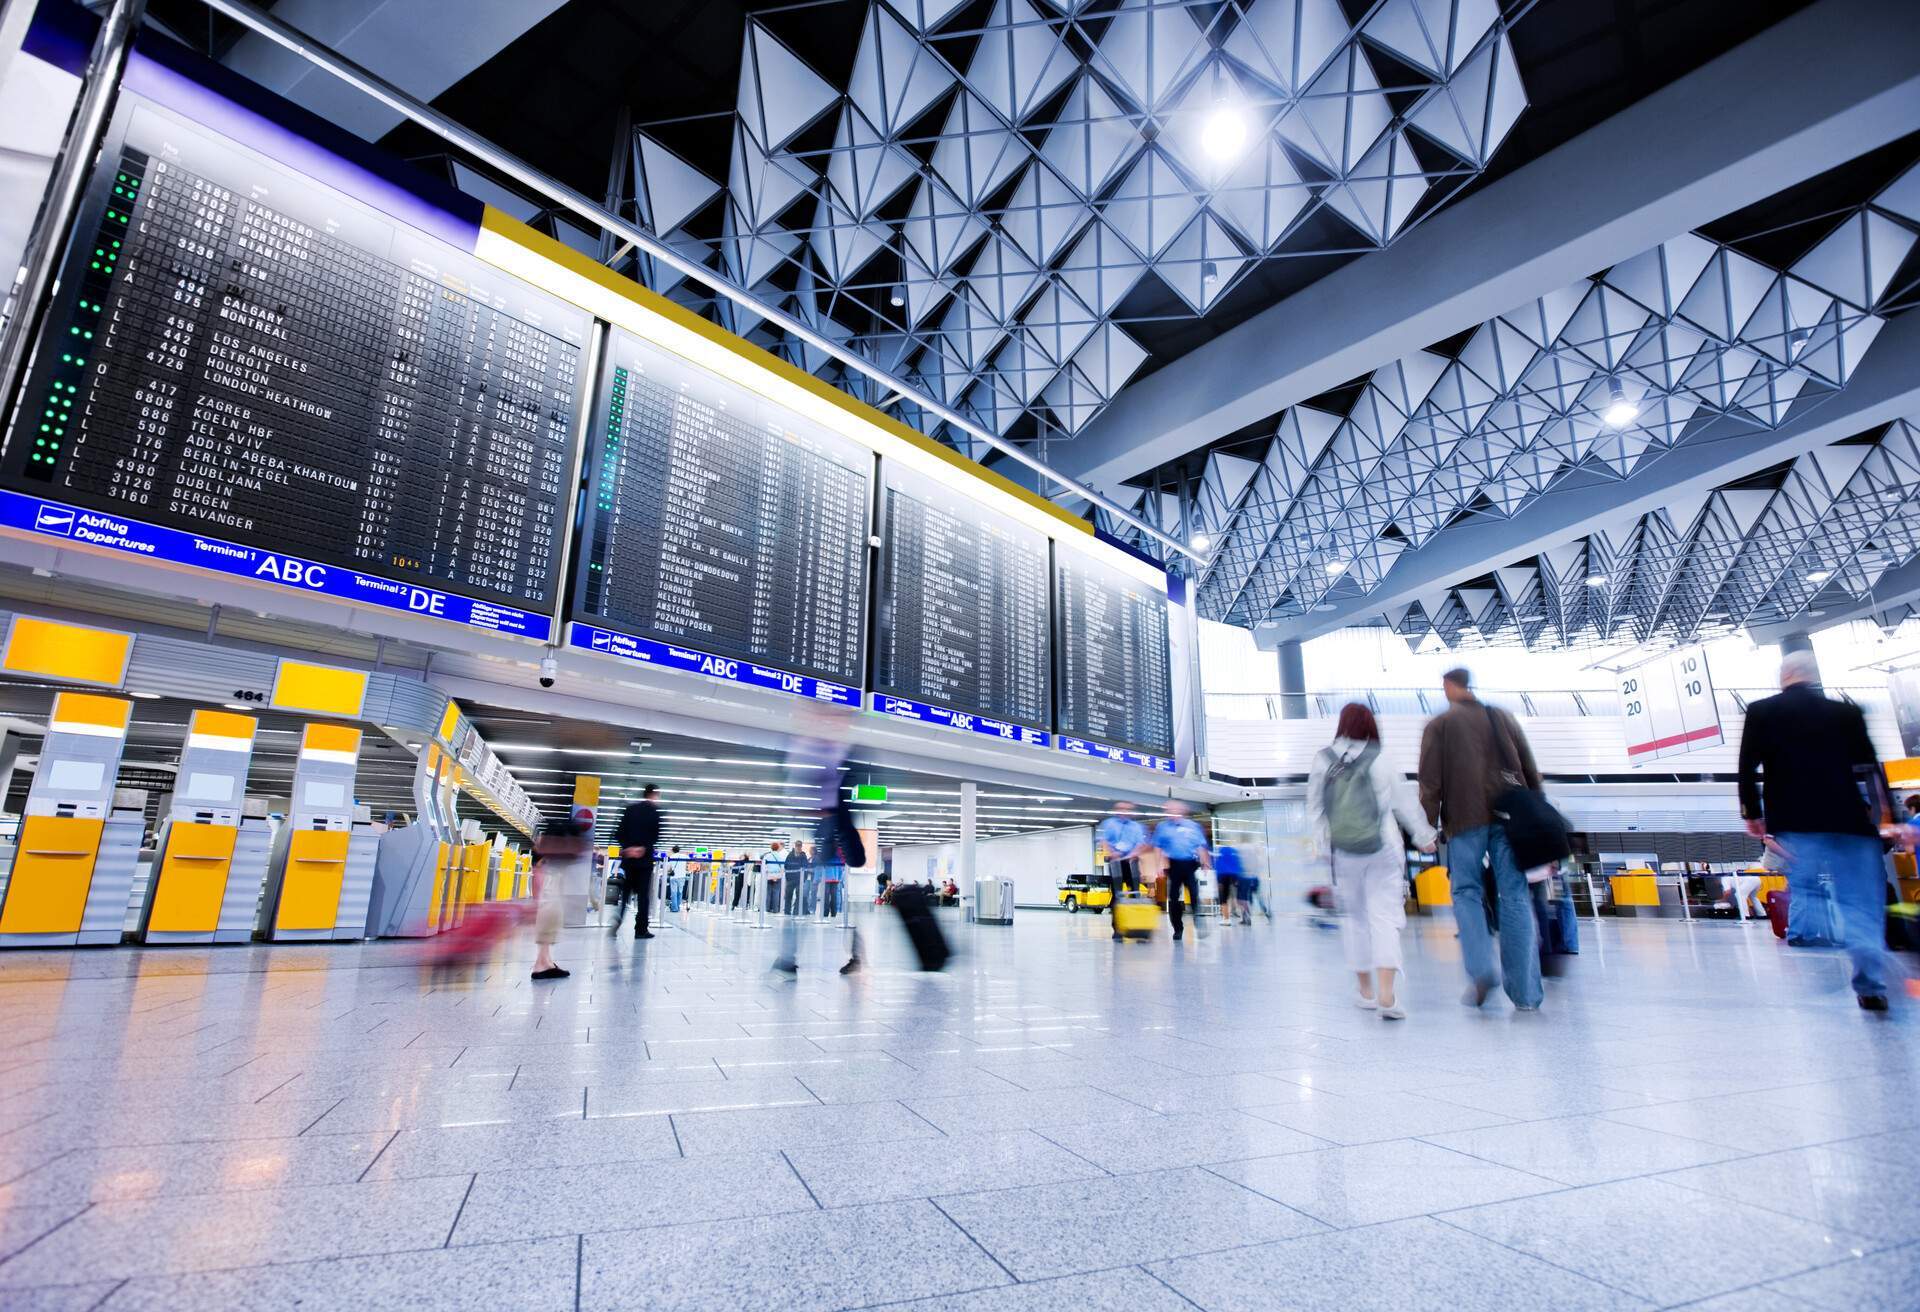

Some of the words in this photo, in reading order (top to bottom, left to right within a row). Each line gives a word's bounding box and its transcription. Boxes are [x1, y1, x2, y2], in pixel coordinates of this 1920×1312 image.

[157, 162, 167, 173] D
[154, 174, 161, 185] L
[191, 191, 227, 213] 3102
[244, 214, 309, 249] HELSINKI
[147, 198, 154, 209] L
[194, 219, 221, 236] 462
[238, 237, 279, 261] MIAMI
[150, 186, 158, 197] L
[198, 207, 224, 224] 468
[241, 225, 308, 260] PORTLAND
[139, 222, 147, 233] L
[178, 238, 214, 259] 3236
[233, 260, 268, 281] IEW
[129, 260, 136, 271] L
[177, 279, 204, 296] 494
[223, 296, 284, 325] CALGARY
[123, 272, 133, 283] A
[174, 290, 201, 308] 875
[220, 308, 287, 340] MONTREAL
[113, 310, 120, 322] L
[163, 329, 191, 346] 442
[210, 344, 271, 373] DETROIT
[117, 297, 124, 308] L
[167, 316, 194, 333] 456
[213, 332, 240, 349] LOS
[248, 345, 308, 373] ANGELES
[109, 323, 117, 335] L
[160, 342, 188, 358] 440
[206, 357, 269, 386] HOUSTON
[105, 336, 113, 348] L
[146, 351, 183, 371] 4726
[204, 370, 332, 419] LONDON-HEATHROW
[93, 377, 100, 388] L
[135, 390, 173, 409] 6808
[193, 408, 239, 430] KOELN
[248, 425, 273, 439] HBF
[149, 380, 177, 396] 417
[196, 396, 251, 420] ZAGREB
[89, 391, 96, 402] L
[141, 406, 169, 423] 686
[192, 421, 215, 437] TEL
[226, 432, 263, 450] AVIV
[81, 418, 88, 430] L
[136, 434, 162, 450] 176
[183, 447, 289, 485] BERLIN-TEGEL
[85, 404, 92, 416] L
[138, 420, 166, 436] 590
[186, 434, 233, 455] ADDIS
[241, 450, 357, 491] ABEBA-KHARTOUM
[73, 446, 80, 458] L
[116, 459, 155, 477] 4980
[176, 474, 233, 497] DUBLIN
[77, 433, 87, 444] J
[133, 447, 159, 463] 117
[180, 461, 261, 491] LJUBLJANA
[69, 461, 76, 472] L
[112, 472, 152, 491] 3126
[172, 487, 229, 510] BERGEN
[65, 475, 72, 487] L
[108, 486, 148, 505] 3160
[169, 501, 253, 530] STAVANGER
[77, 513, 129, 536] Abflug
[664, 523, 697, 540] DETROIT
[665, 514, 699, 531] CHICAGO
[74, 527, 156, 553] Departures
[194, 539, 248, 558] Terminal
[250, 551, 257, 561] 1
[257, 556, 326, 589] ABC
[659, 571, 693, 588] VILNIUS
[660, 562, 703, 581] NUERNBERG
[354, 575, 398, 593] Terminal
[399, 585, 408, 596] 2
[659, 581, 692, 597] TORONTO
[409, 589, 446, 615] DE
[656, 602, 700, 619] AMSTERDAM
[657, 591, 695, 608] HELSINKI
[654, 621, 684, 635] DUBLIN
[655, 611, 712, 633] POZNAN/POSEN
[611, 645, 651, 661] Departures
[612, 635, 637, 649] Abflug
[669, 648, 697, 661] Terminal
[1680, 657, 1697, 674] 10
[701, 658, 738, 679] ABC
[752, 667, 776, 679] Terminal
[782, 674, 803, 693] DE
[1622, 678, 1638, 695] 20
[1685, 680, 1702, 697] 10
[233, 690, 263, 702] 464
[1626, 700, 1642, 717] 20
[950, 714, 973, 731] ABC
[1000, 724, 1013, 739] DE
[1108, 748, 1124, 761] ABC
